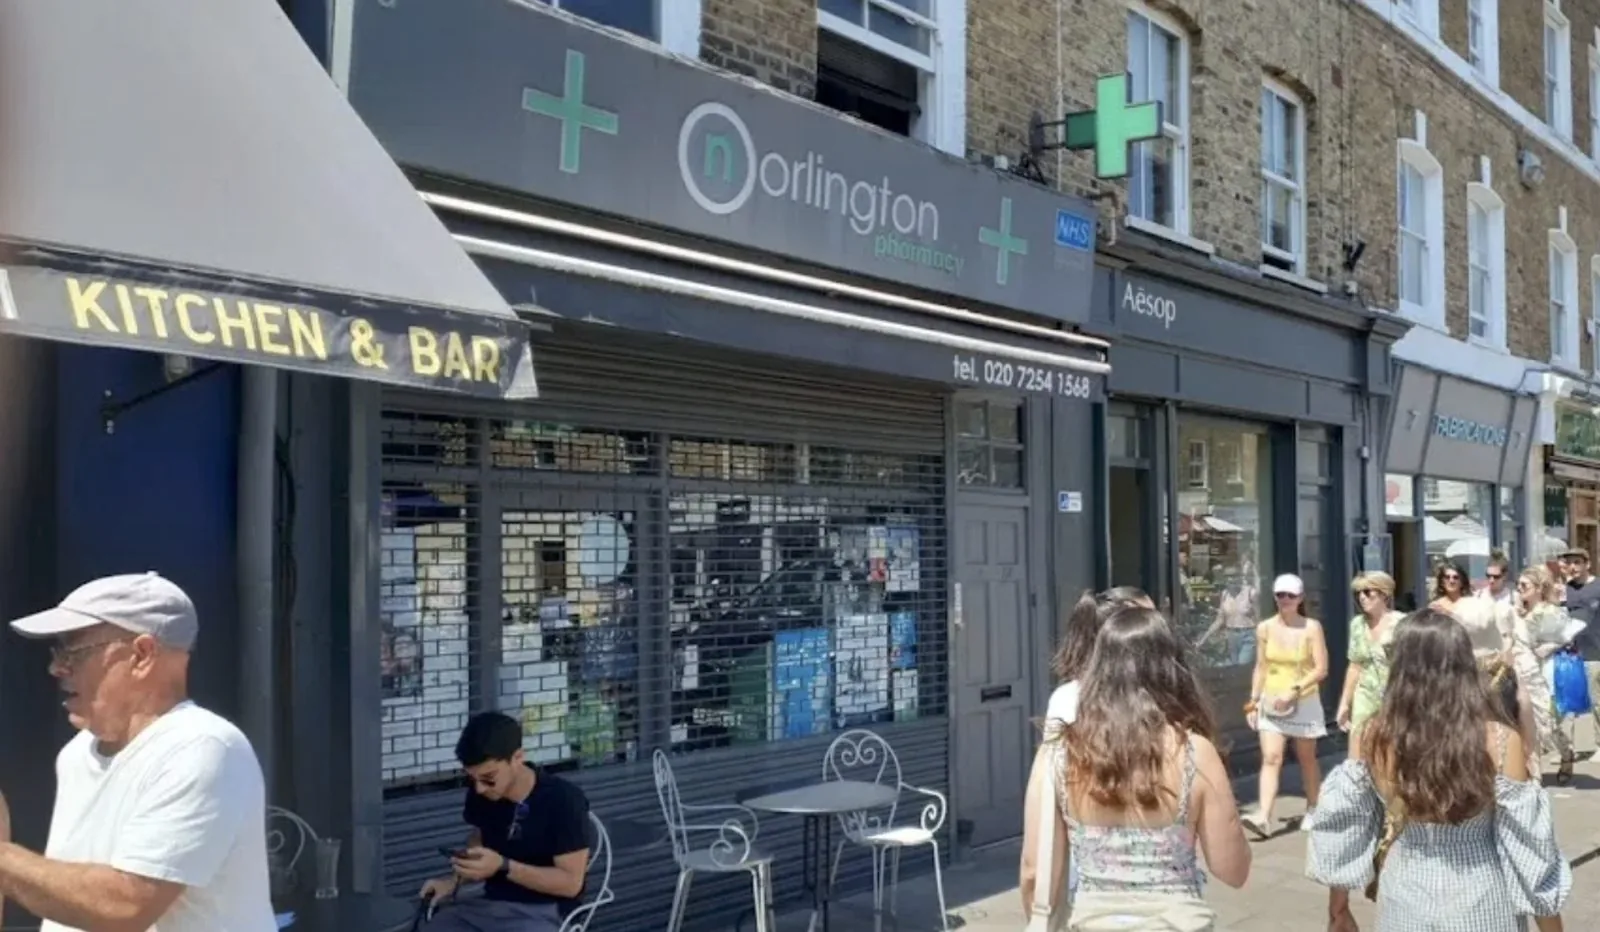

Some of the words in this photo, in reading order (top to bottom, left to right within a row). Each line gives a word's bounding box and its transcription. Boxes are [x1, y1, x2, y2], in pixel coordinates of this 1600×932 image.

[1060, 214, 1090, 244] NHS
[874, 231, 965, 278] pharmacy
[66, 277, 328, 360] KITCHEN
[350, 318, 389, 370] &
[408, 325, 499, 383] BAR
[953, 354, 979, 383] tel.
[984, 360, 1014, 386] 020
[1017, 366, 1053, 393] 7254
[1057, 372, 1090, 398] 1568
